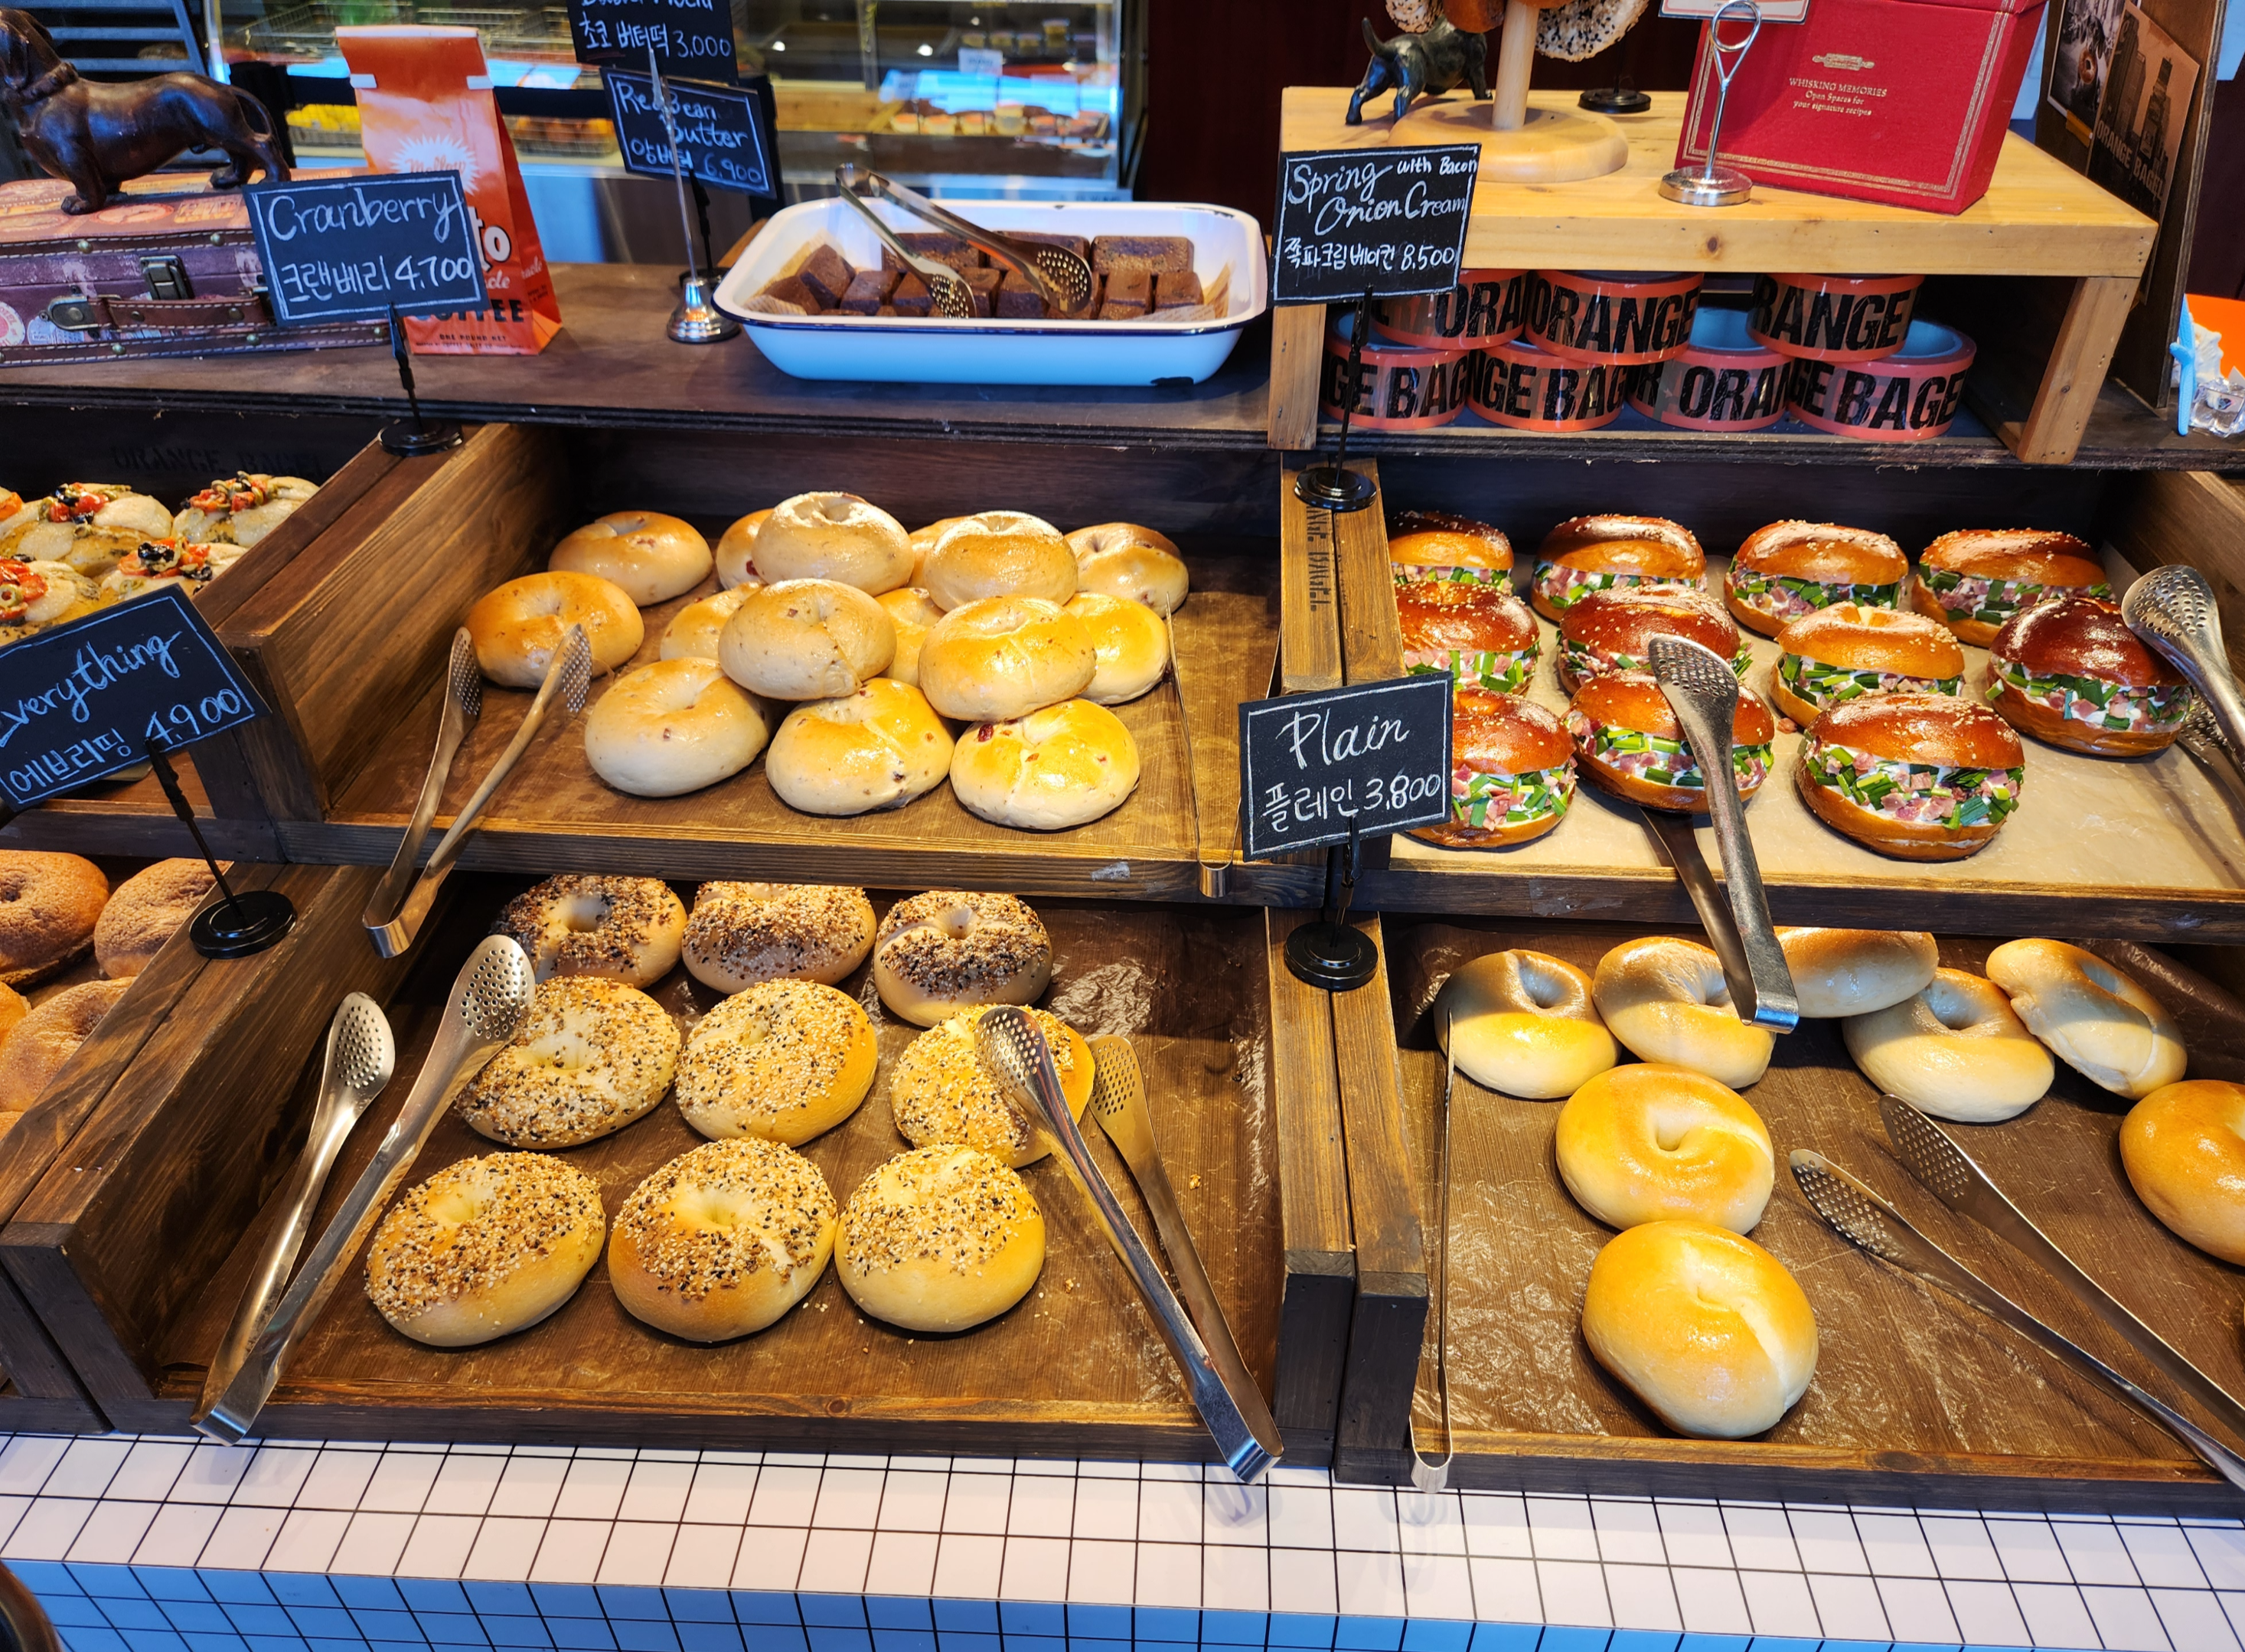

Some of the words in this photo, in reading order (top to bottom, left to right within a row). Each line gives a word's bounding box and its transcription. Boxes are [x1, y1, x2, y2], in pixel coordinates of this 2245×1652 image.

[579, 11, 612, 49] 초코
[616, 20, 670, 57] 버터떡
[1789, 78, 1836, 90] WHISKING
[1839, 83, 1888, 97] MEMORIES
[1793, 100, 1810, 109] your
[1812, 103, 1844, 113] signature
[1845, 107, 1872, 116] recipes
[1805, 90, 1826, 101] Open
[1827, 93, 1852, 103] Spaces
[1852, 96, 1865, 105] for
[1287, 162, 1393, 214] Spring
[1397, 156, 1432, 175] with
[1439, 155, 1477, 175] Bacon
[2097, 119, 2133, 169] ORANGE
[2133, 155, 2165, 201] BAGEL
[269, 188, 463, 243] Cranberry
[1314, 196, 1402, 236] Onion
[1405, 181, 1466, 219] Cream
[281, 256, 391, 302] 크랜베리
[1531, 277, 1700, 354] ORANGE
[1275, 707, 1411, 770] Plain
[1263, 779, 1359, 833] 플레인
